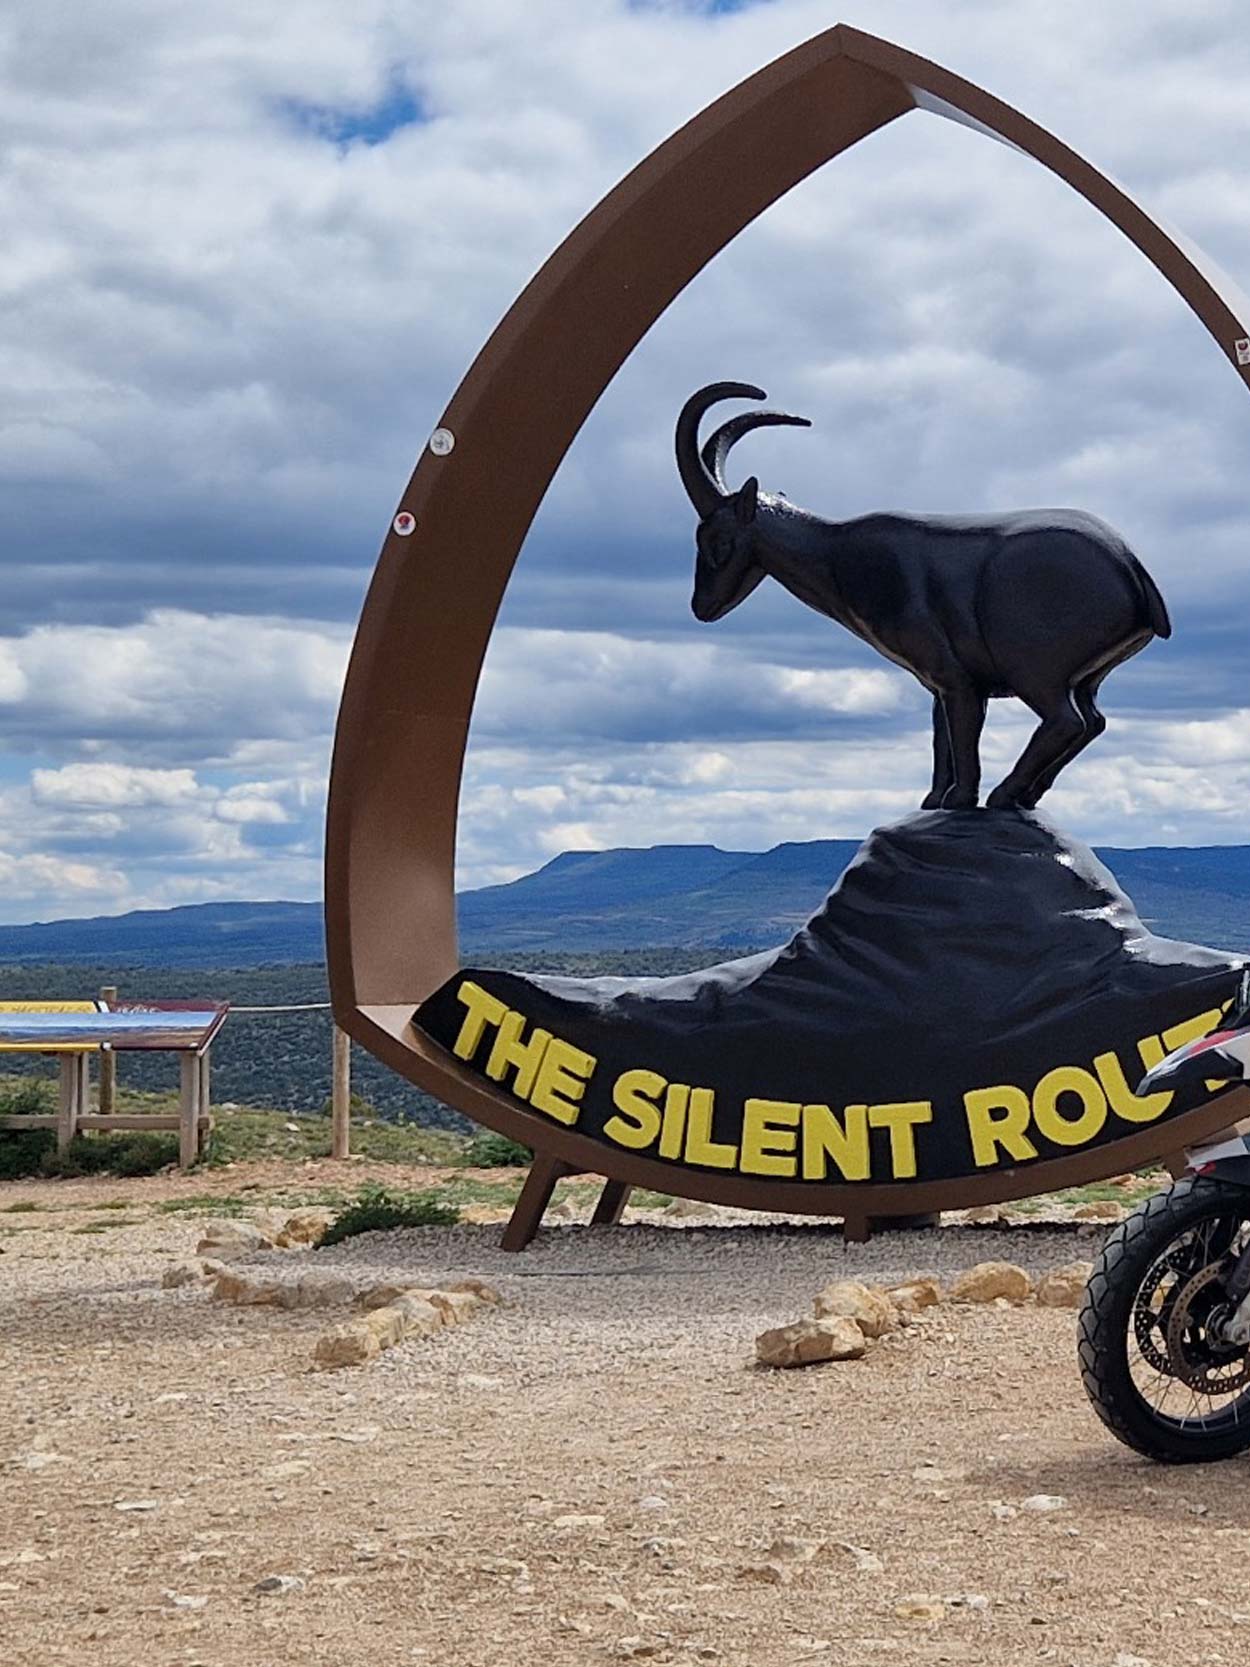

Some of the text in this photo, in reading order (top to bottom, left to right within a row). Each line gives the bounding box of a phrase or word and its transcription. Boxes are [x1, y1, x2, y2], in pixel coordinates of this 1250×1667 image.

[452, 980, 1236, 1181] THE SILENT ROUT
